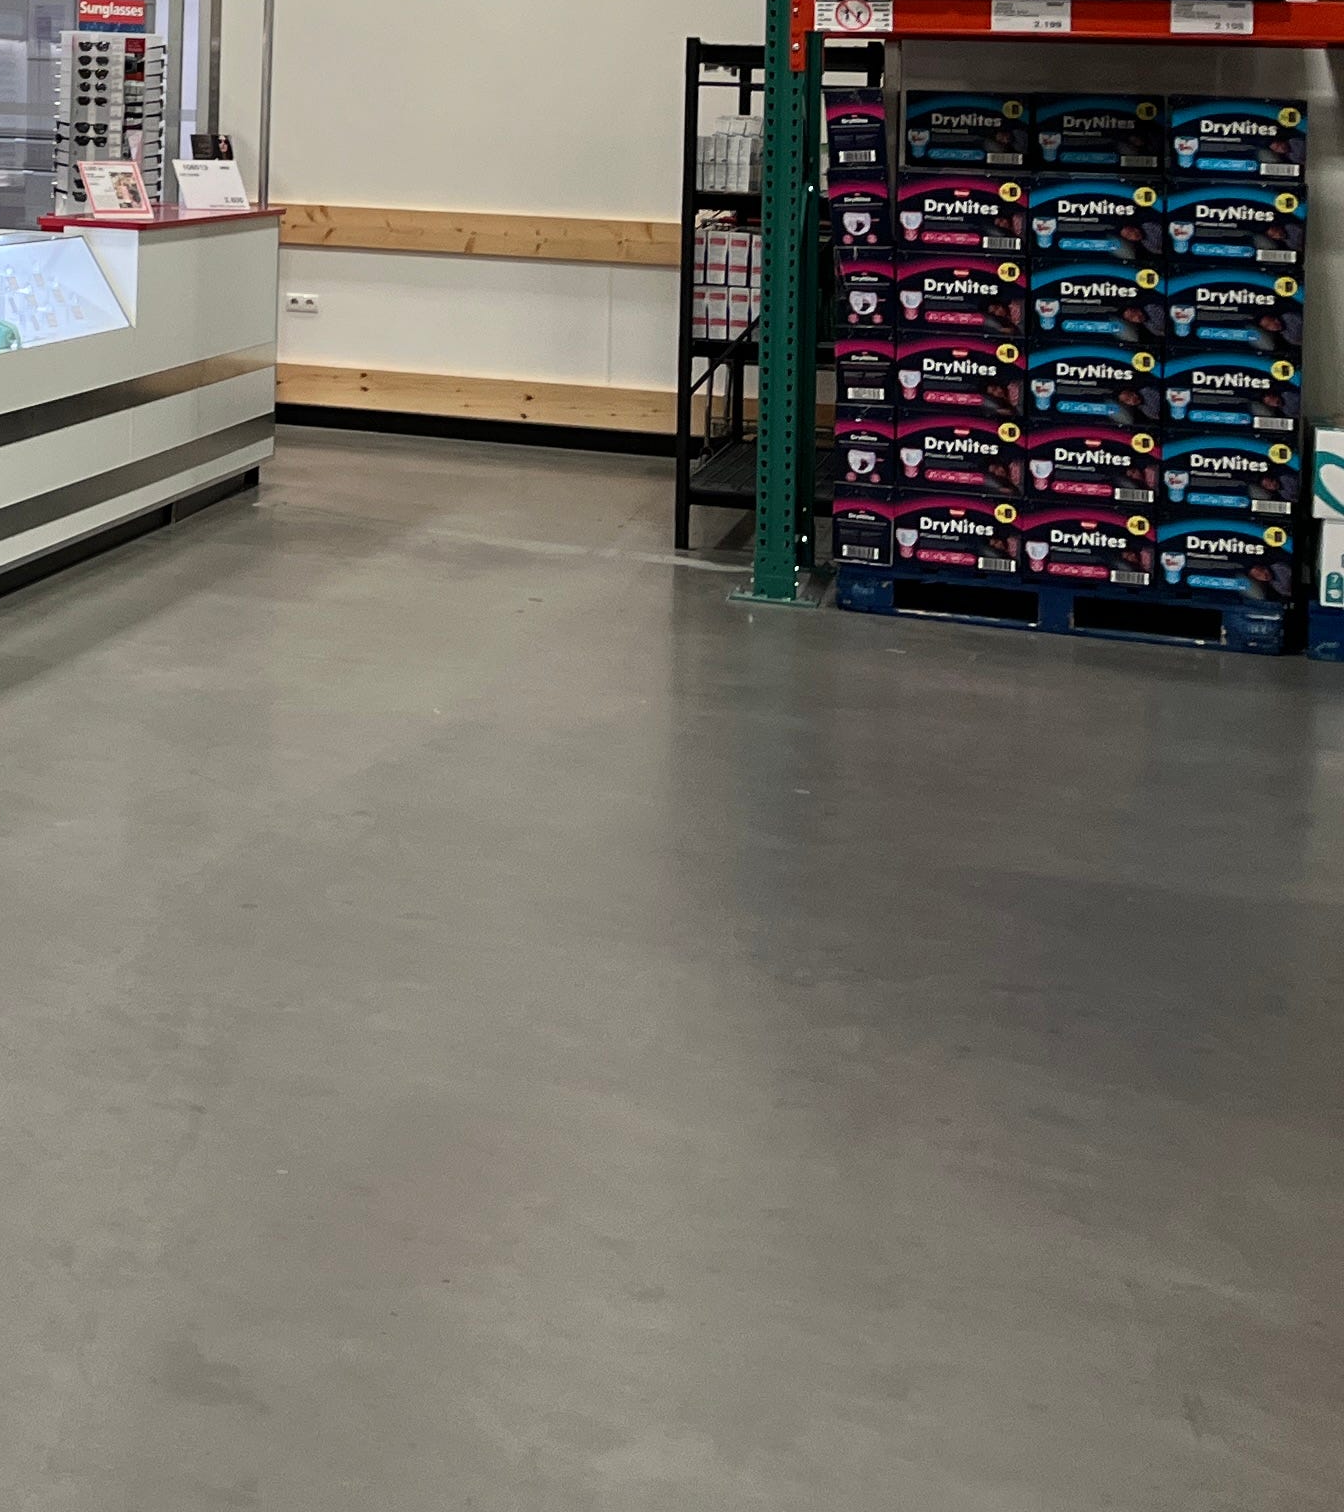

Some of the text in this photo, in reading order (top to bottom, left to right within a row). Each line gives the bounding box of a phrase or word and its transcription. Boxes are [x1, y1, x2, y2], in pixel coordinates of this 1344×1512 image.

[79, 1, 144, 18] Sunglasses
[1200, 119, 1278, 136] DryNites
[924, 198, 999, 216] DryNites
[1058, 199, 1136, 217] DryNites
[1196, 204, 1275, 222] DryNites
[924, 278, 999, 296] DryNites
[1060, 281, 1138, 299] DryNites
[1196, 288, 1276, 306] DryNites
[922, 358, 998, 377] DryNites
[1056, 362, 1134, 381] DryNites
[1192, 371, 1271, 389] DryNites
[924, 436, 999, 455] DryNites
[1054, 447, 1132, 467] DryNites
[1190, 453, 1269, 472] DryNites
[919, 516, 994, 536] DryNites
[1050, 529, 1127, 549] DryNites
[1186, 535, 1265, 555] DryNites
